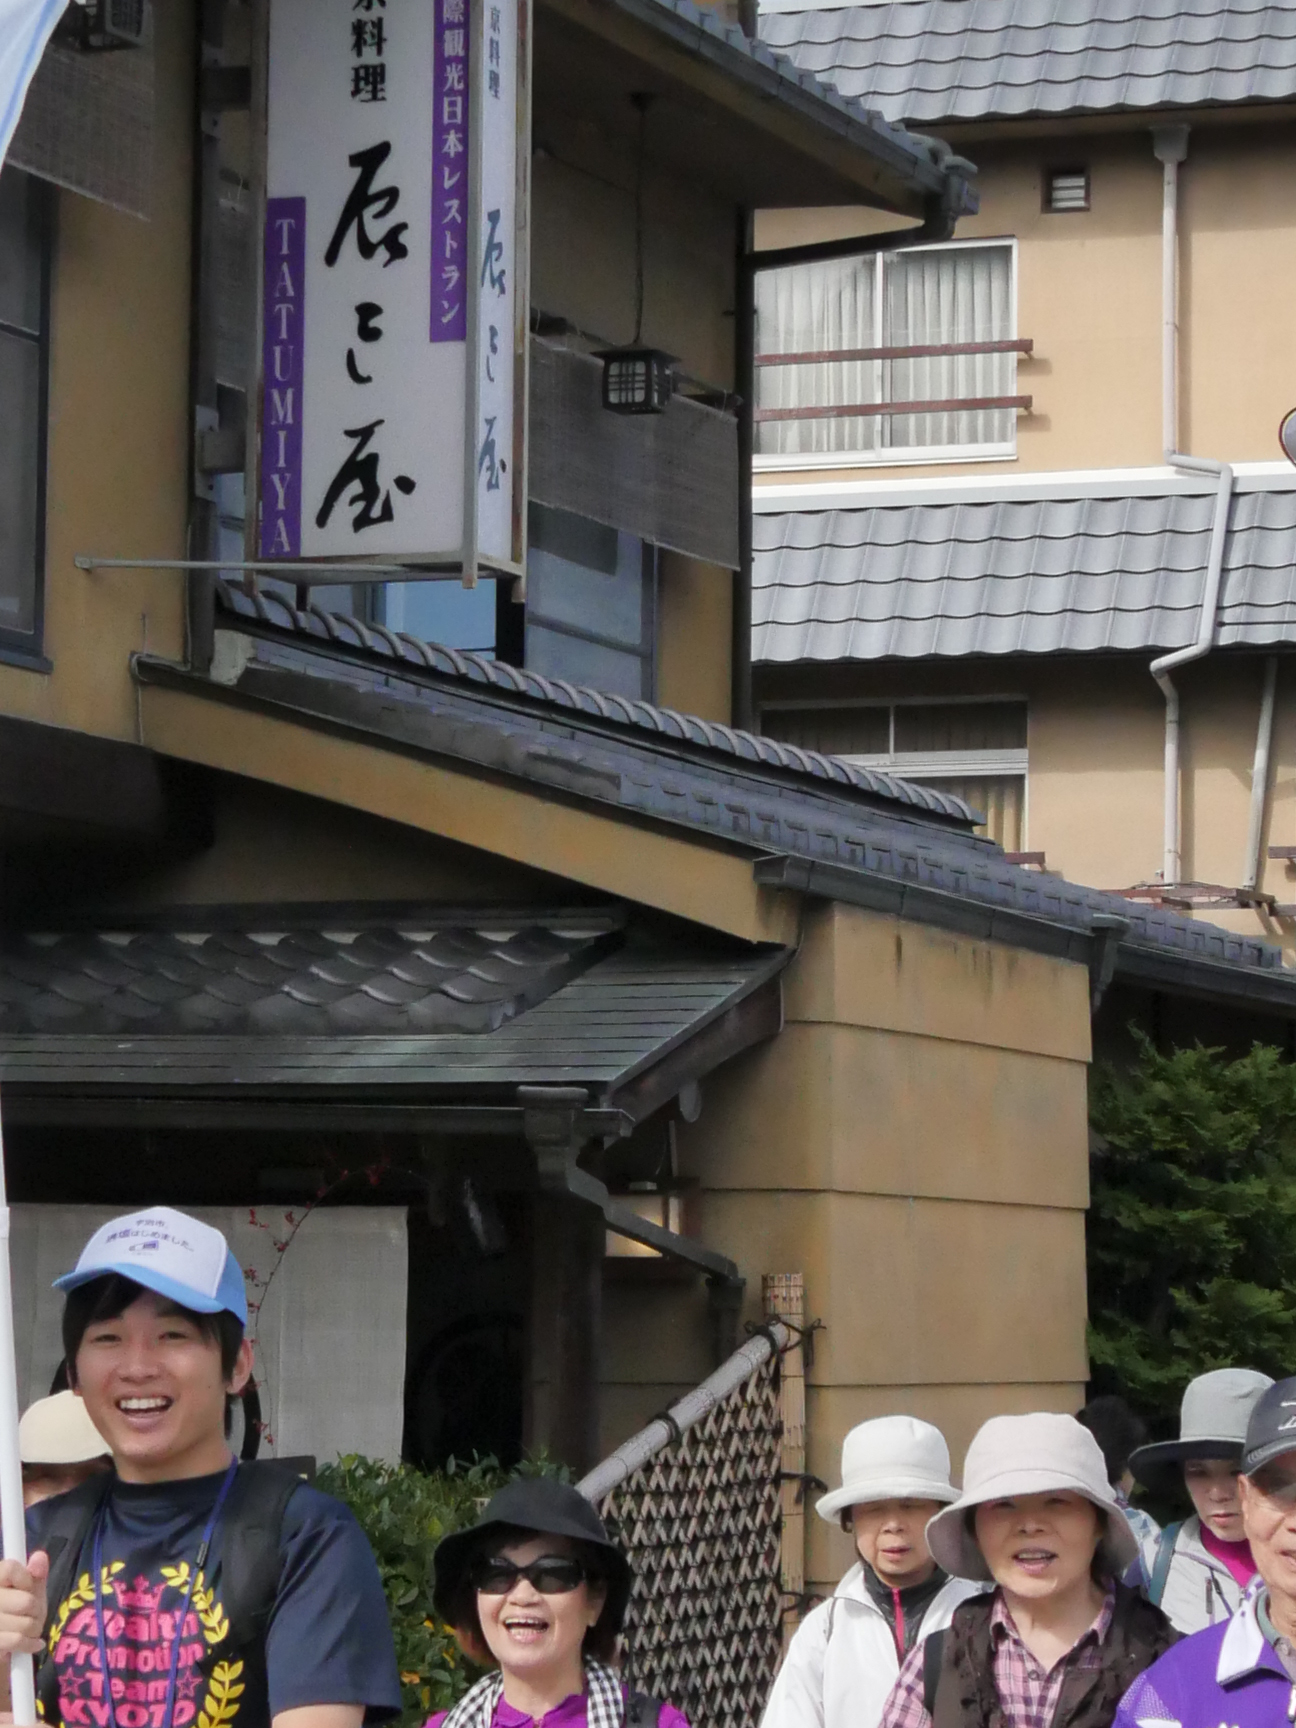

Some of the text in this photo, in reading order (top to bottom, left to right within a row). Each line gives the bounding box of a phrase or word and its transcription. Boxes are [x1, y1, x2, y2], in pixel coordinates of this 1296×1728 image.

[488, 5, 502, 100] 京料理
[268, 218, 296, 554] TATUMIYA
[66, 1607, 199, 1642] Health
[85, 1670, 171, 1702] Team
[59, 1696, 196, 1728] KYOTO
